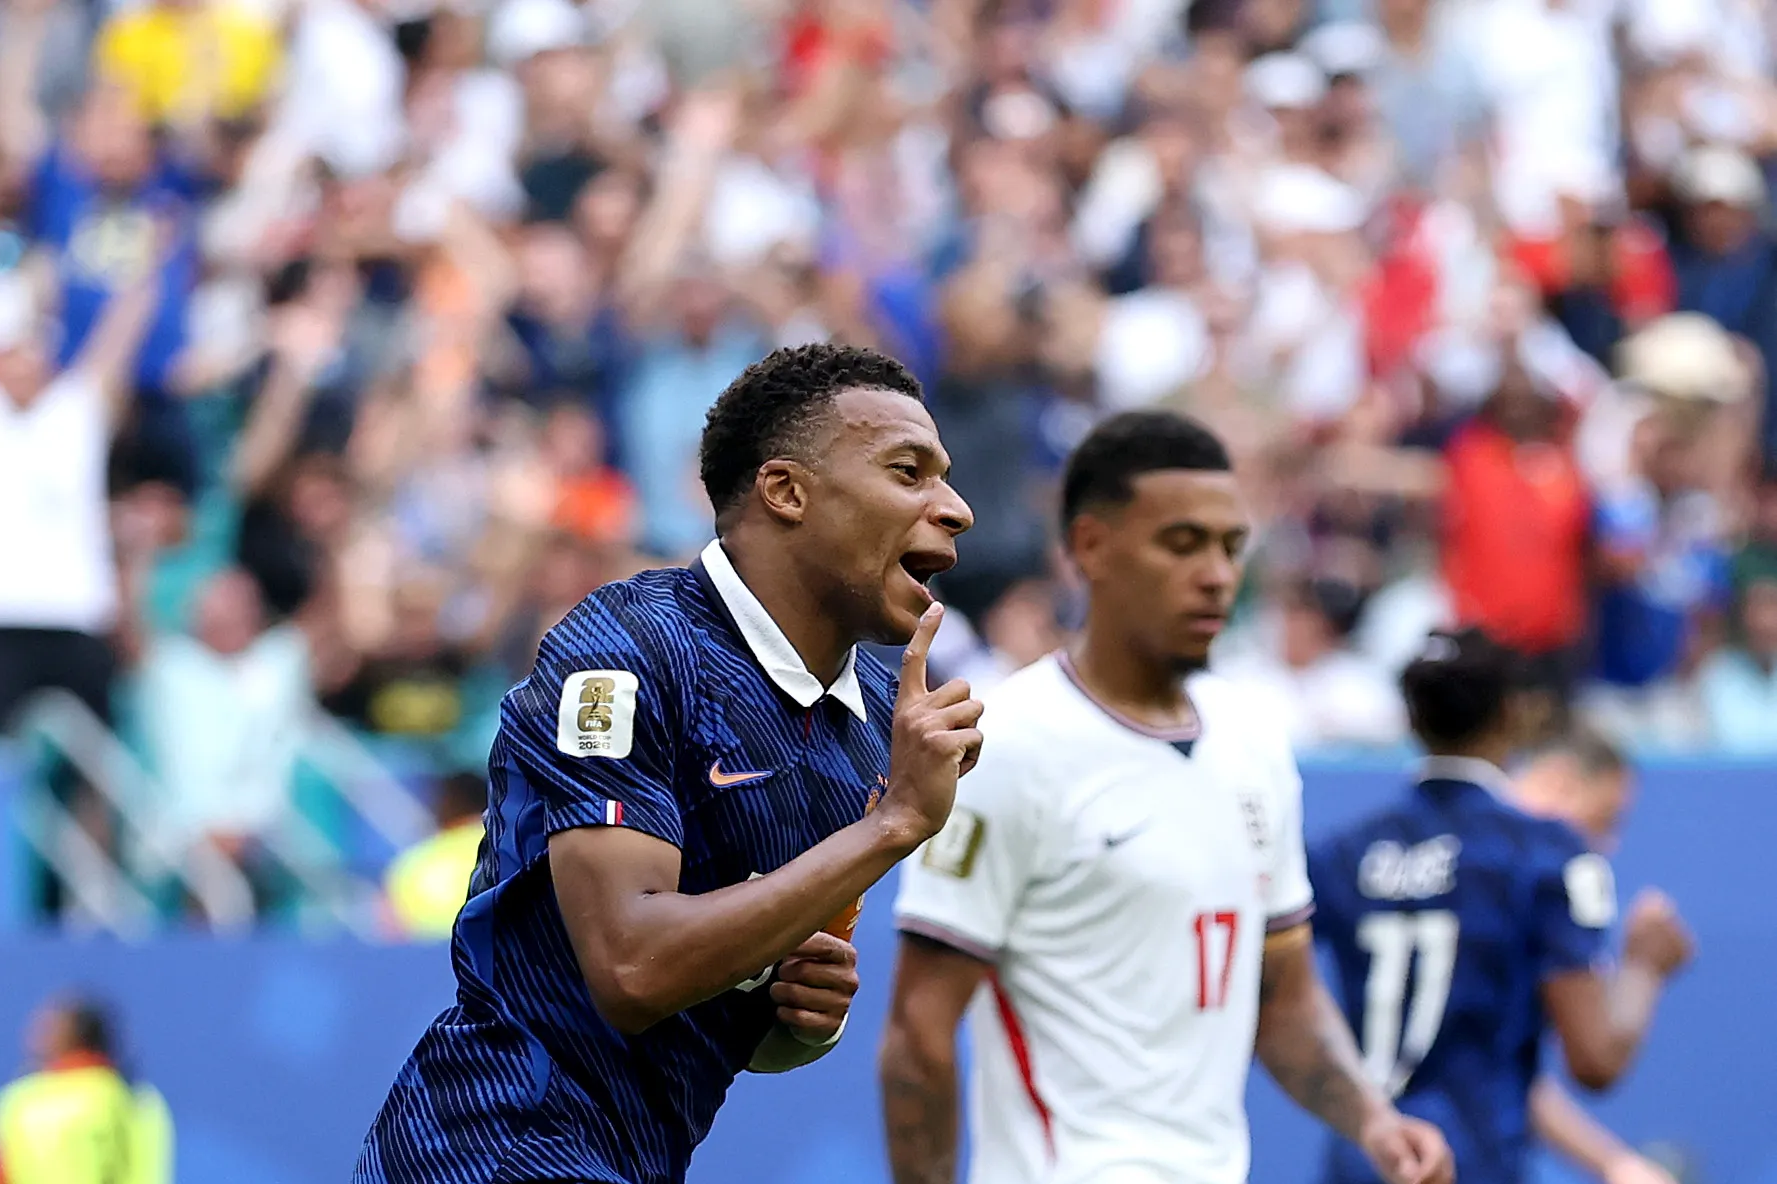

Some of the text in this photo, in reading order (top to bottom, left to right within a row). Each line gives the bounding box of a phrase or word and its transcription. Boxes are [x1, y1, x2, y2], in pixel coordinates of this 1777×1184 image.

[585, 719, 603, 728] FIFA
[578, 741, 611, 750] 2026
[1193, 910, 1240, 1011] 17
